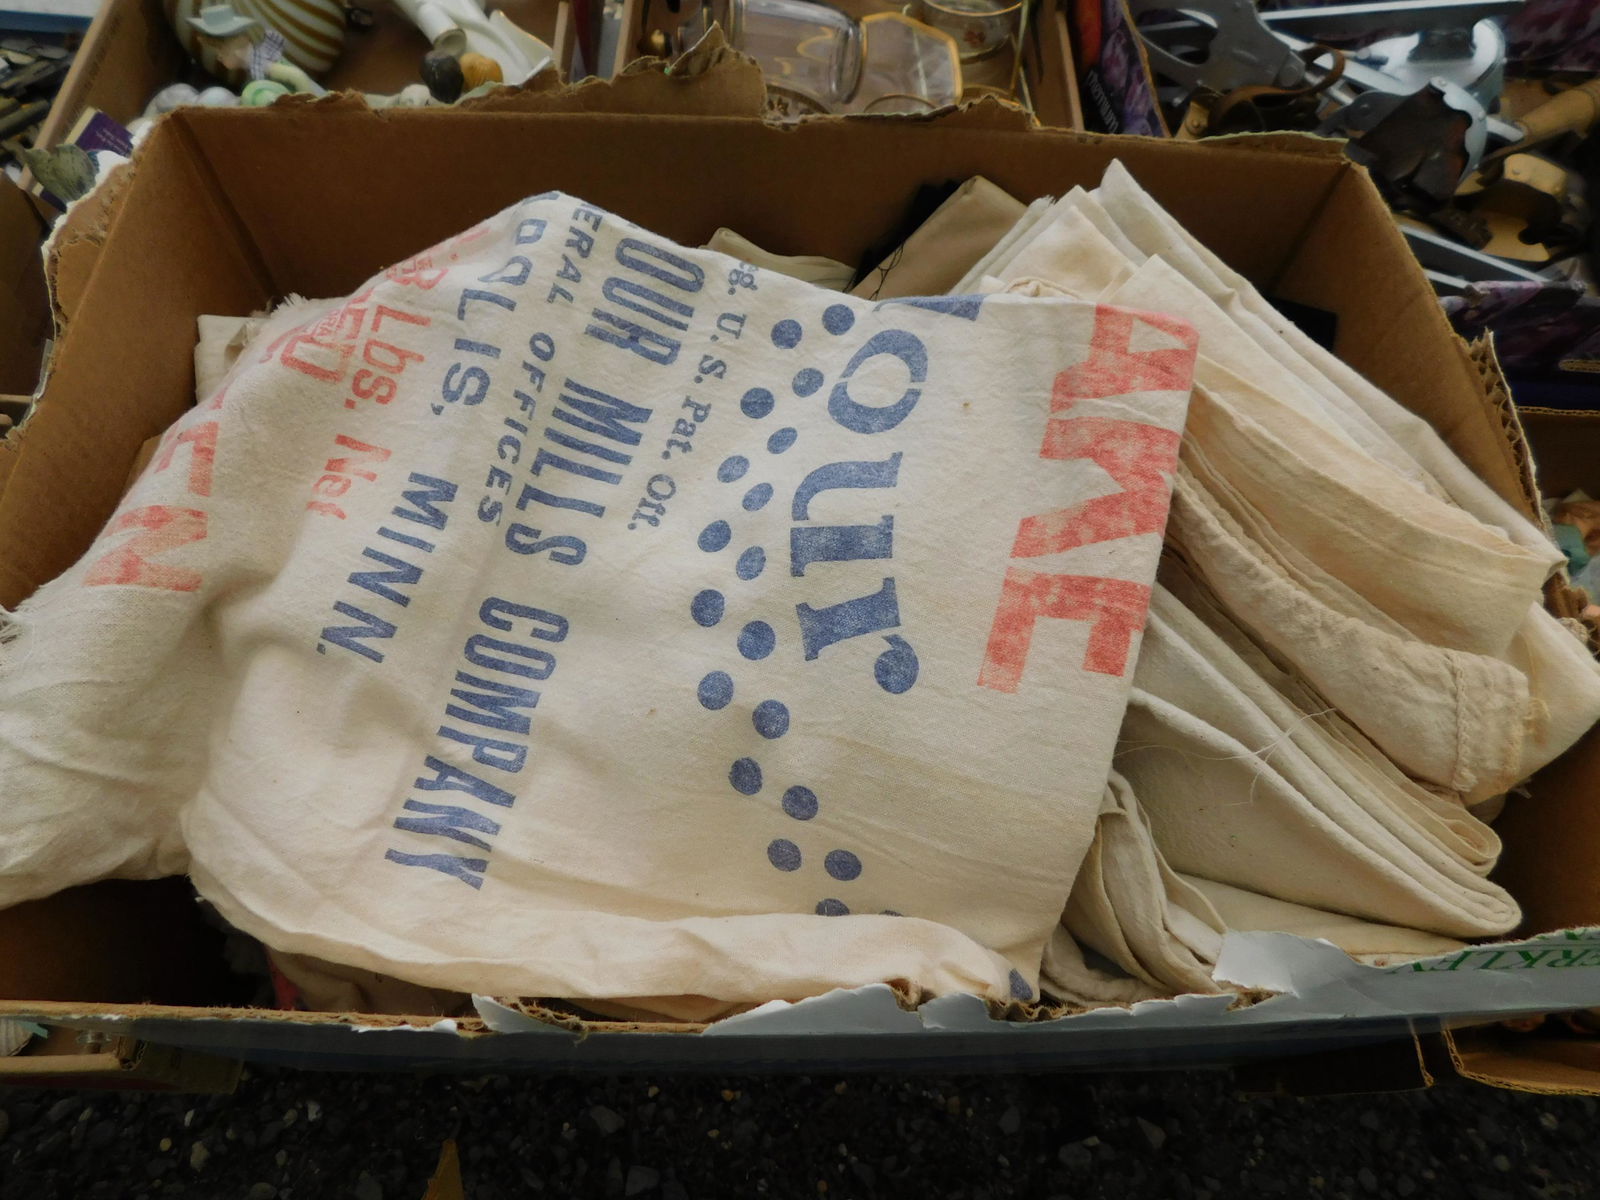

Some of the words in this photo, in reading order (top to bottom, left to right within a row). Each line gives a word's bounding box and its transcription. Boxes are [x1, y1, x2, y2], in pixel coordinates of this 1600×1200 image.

[546, 204, 603, 304] ERAL
[584, 235, 705, 367] OUR
[343, 304, 432, 409] Lbs.
[694, 354, 727, 384] S.
[710, 312, 747, 341] U.
[304, 433, 392, 521] Net
[477, 331, 556, 527] OFFICES
[505, 377, 653, 567] MILLS
[661, 395, 712, 460] Pat.
[627, 473, 677, 531] Off.
[316, 472, 459, 665] MINN.
[383, 596, 570, 891] COMPANY
